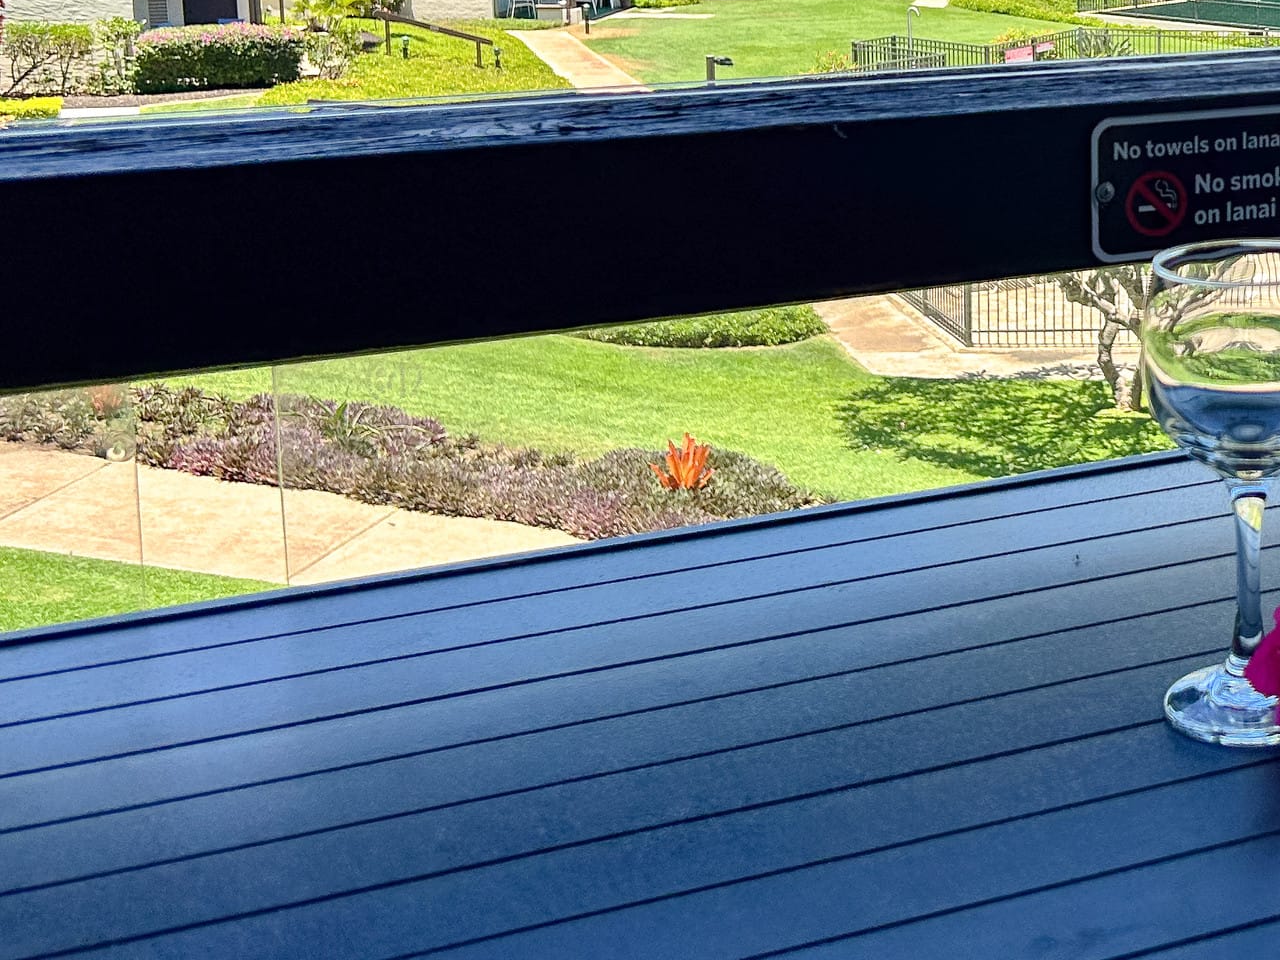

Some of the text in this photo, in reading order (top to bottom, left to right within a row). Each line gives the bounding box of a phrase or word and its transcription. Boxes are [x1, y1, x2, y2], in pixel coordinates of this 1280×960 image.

[1113, 141, 1141, 160] No
[1145, 136, 1209, 158] towels
[1214, 136, 1237, 152] on
[1194, 173, 1225, 194] No
[1194, 197, 1276, 225] on lanai
